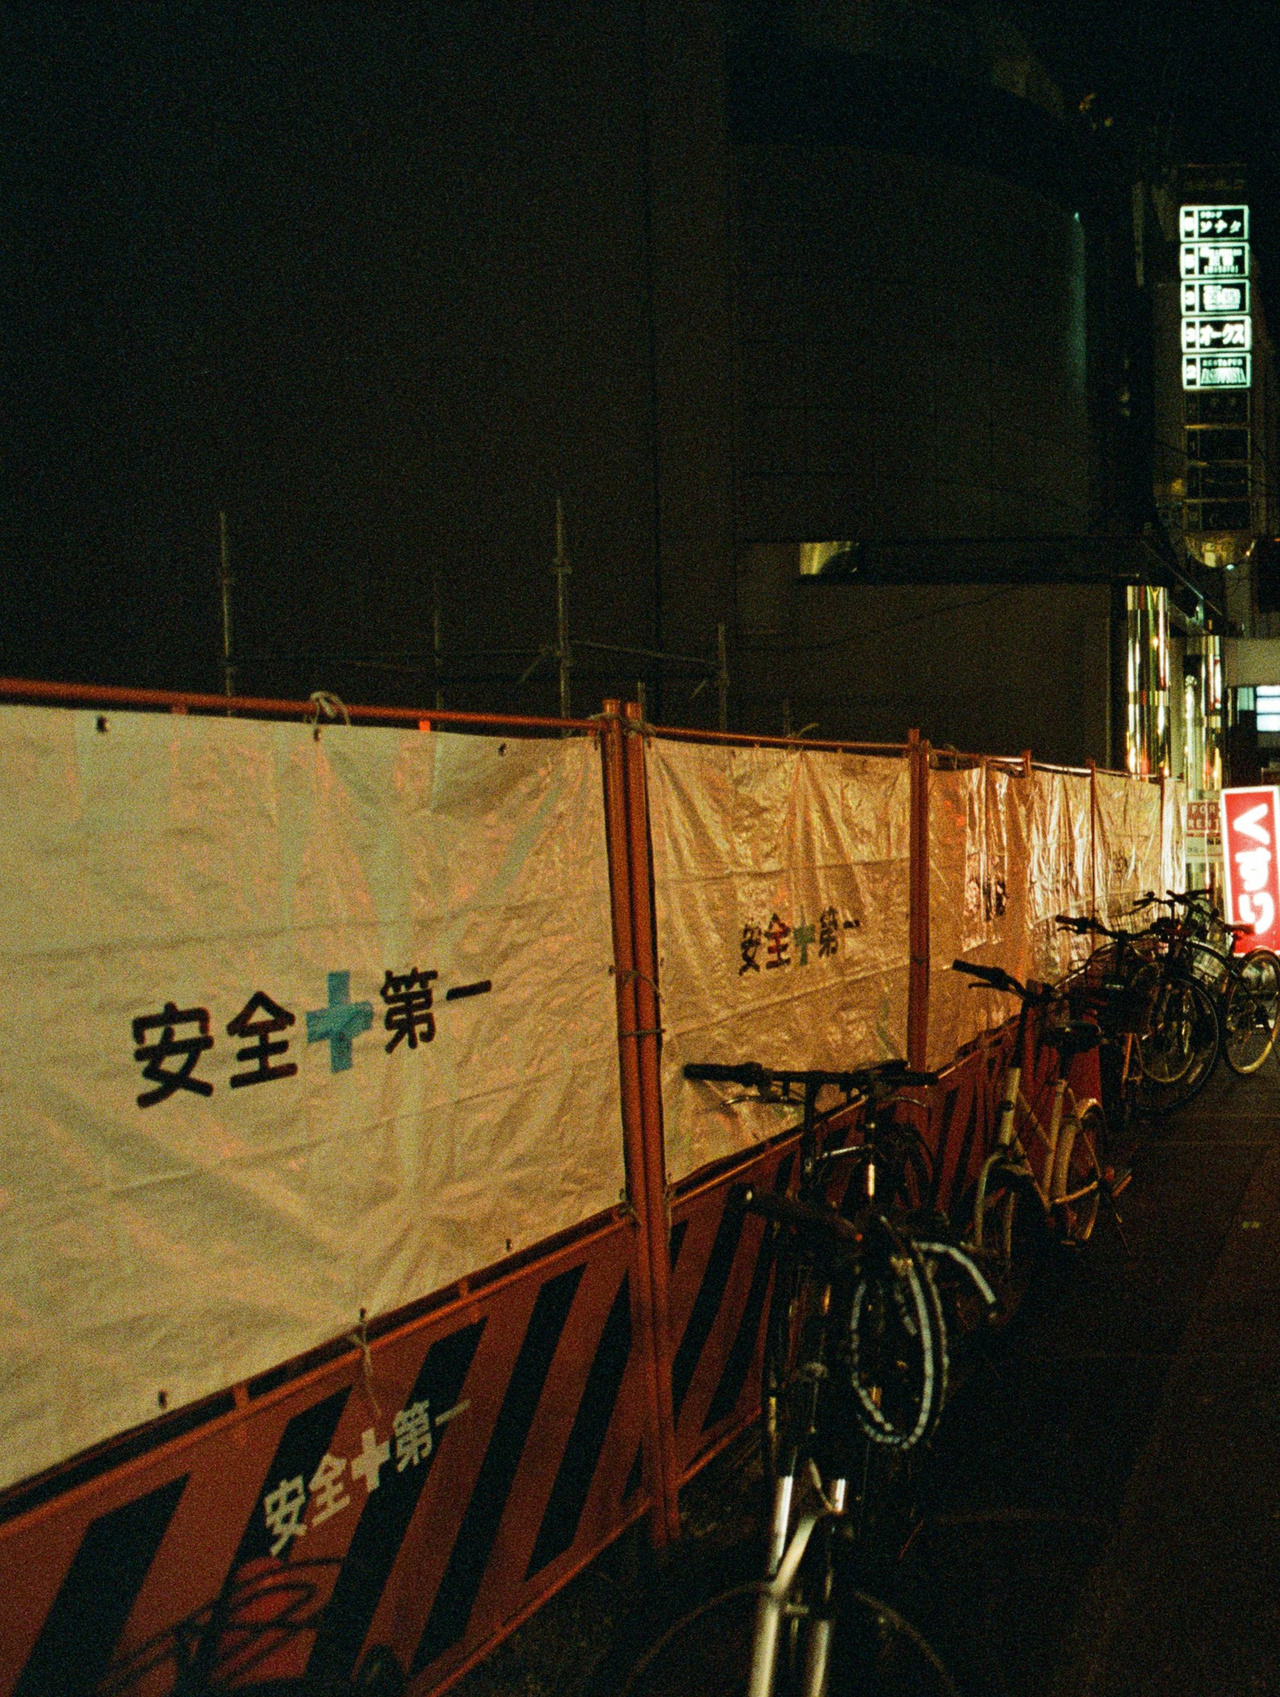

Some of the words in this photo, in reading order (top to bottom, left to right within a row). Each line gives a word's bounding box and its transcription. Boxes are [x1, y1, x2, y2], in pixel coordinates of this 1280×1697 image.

[1200, 323, 1245, 346] オークス
[1191, 804, 1216, 815] FOR
[1233, 803, 1274, 934] くすり
